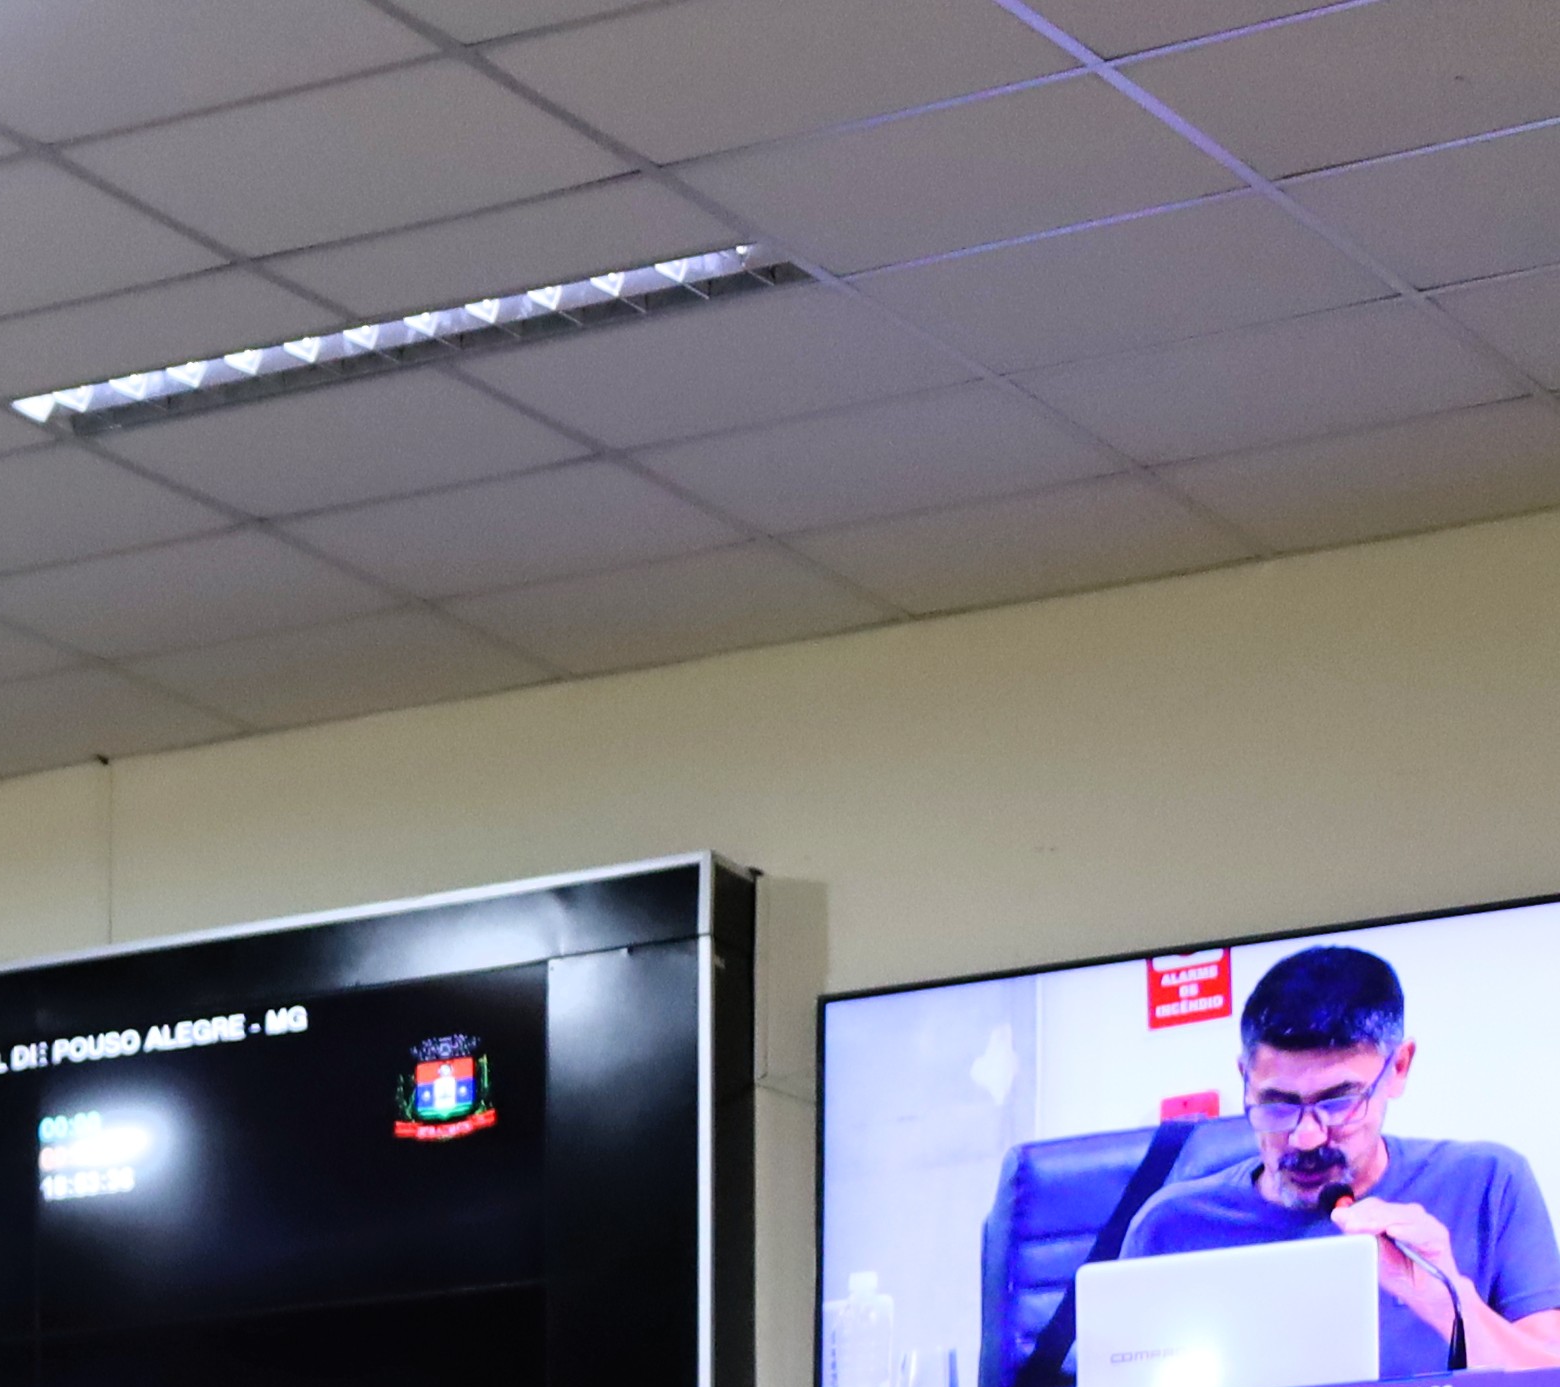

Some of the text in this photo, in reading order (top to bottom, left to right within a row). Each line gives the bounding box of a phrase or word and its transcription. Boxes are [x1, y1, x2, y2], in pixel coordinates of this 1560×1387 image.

[52, 1029, 141, 1064] POUSO
[144, 1013, 246, 1053] ALEGRE
[265, 1005, 308, 1035] MG
[1109, 1346, 1187, 1365] COMPA
